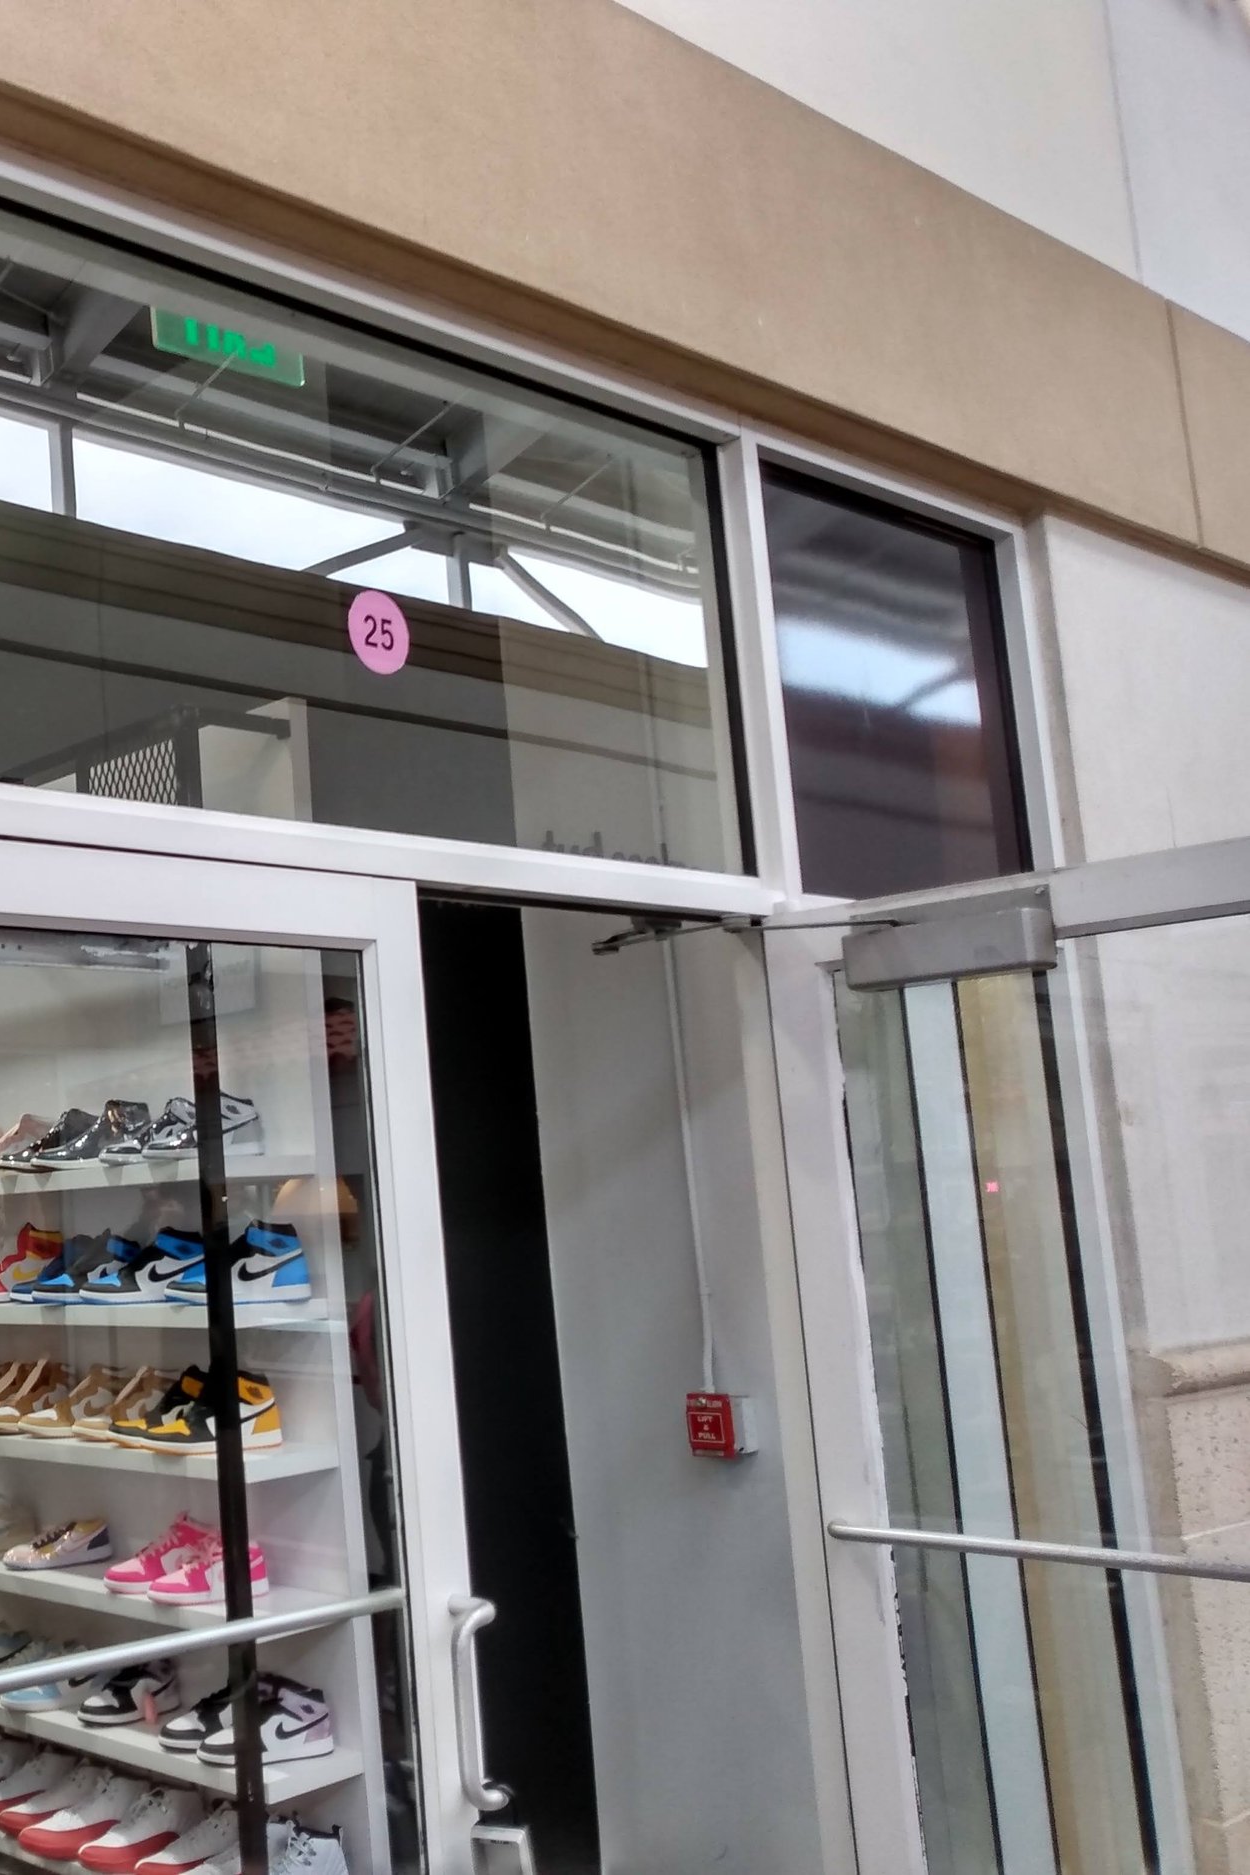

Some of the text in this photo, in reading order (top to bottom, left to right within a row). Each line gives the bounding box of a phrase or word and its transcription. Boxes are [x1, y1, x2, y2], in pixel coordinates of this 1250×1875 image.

[363, 614, 395, 652] 25
[696, 1415, 713, 1423] LIFT
[697, 1432, 717, 1440] PULL
